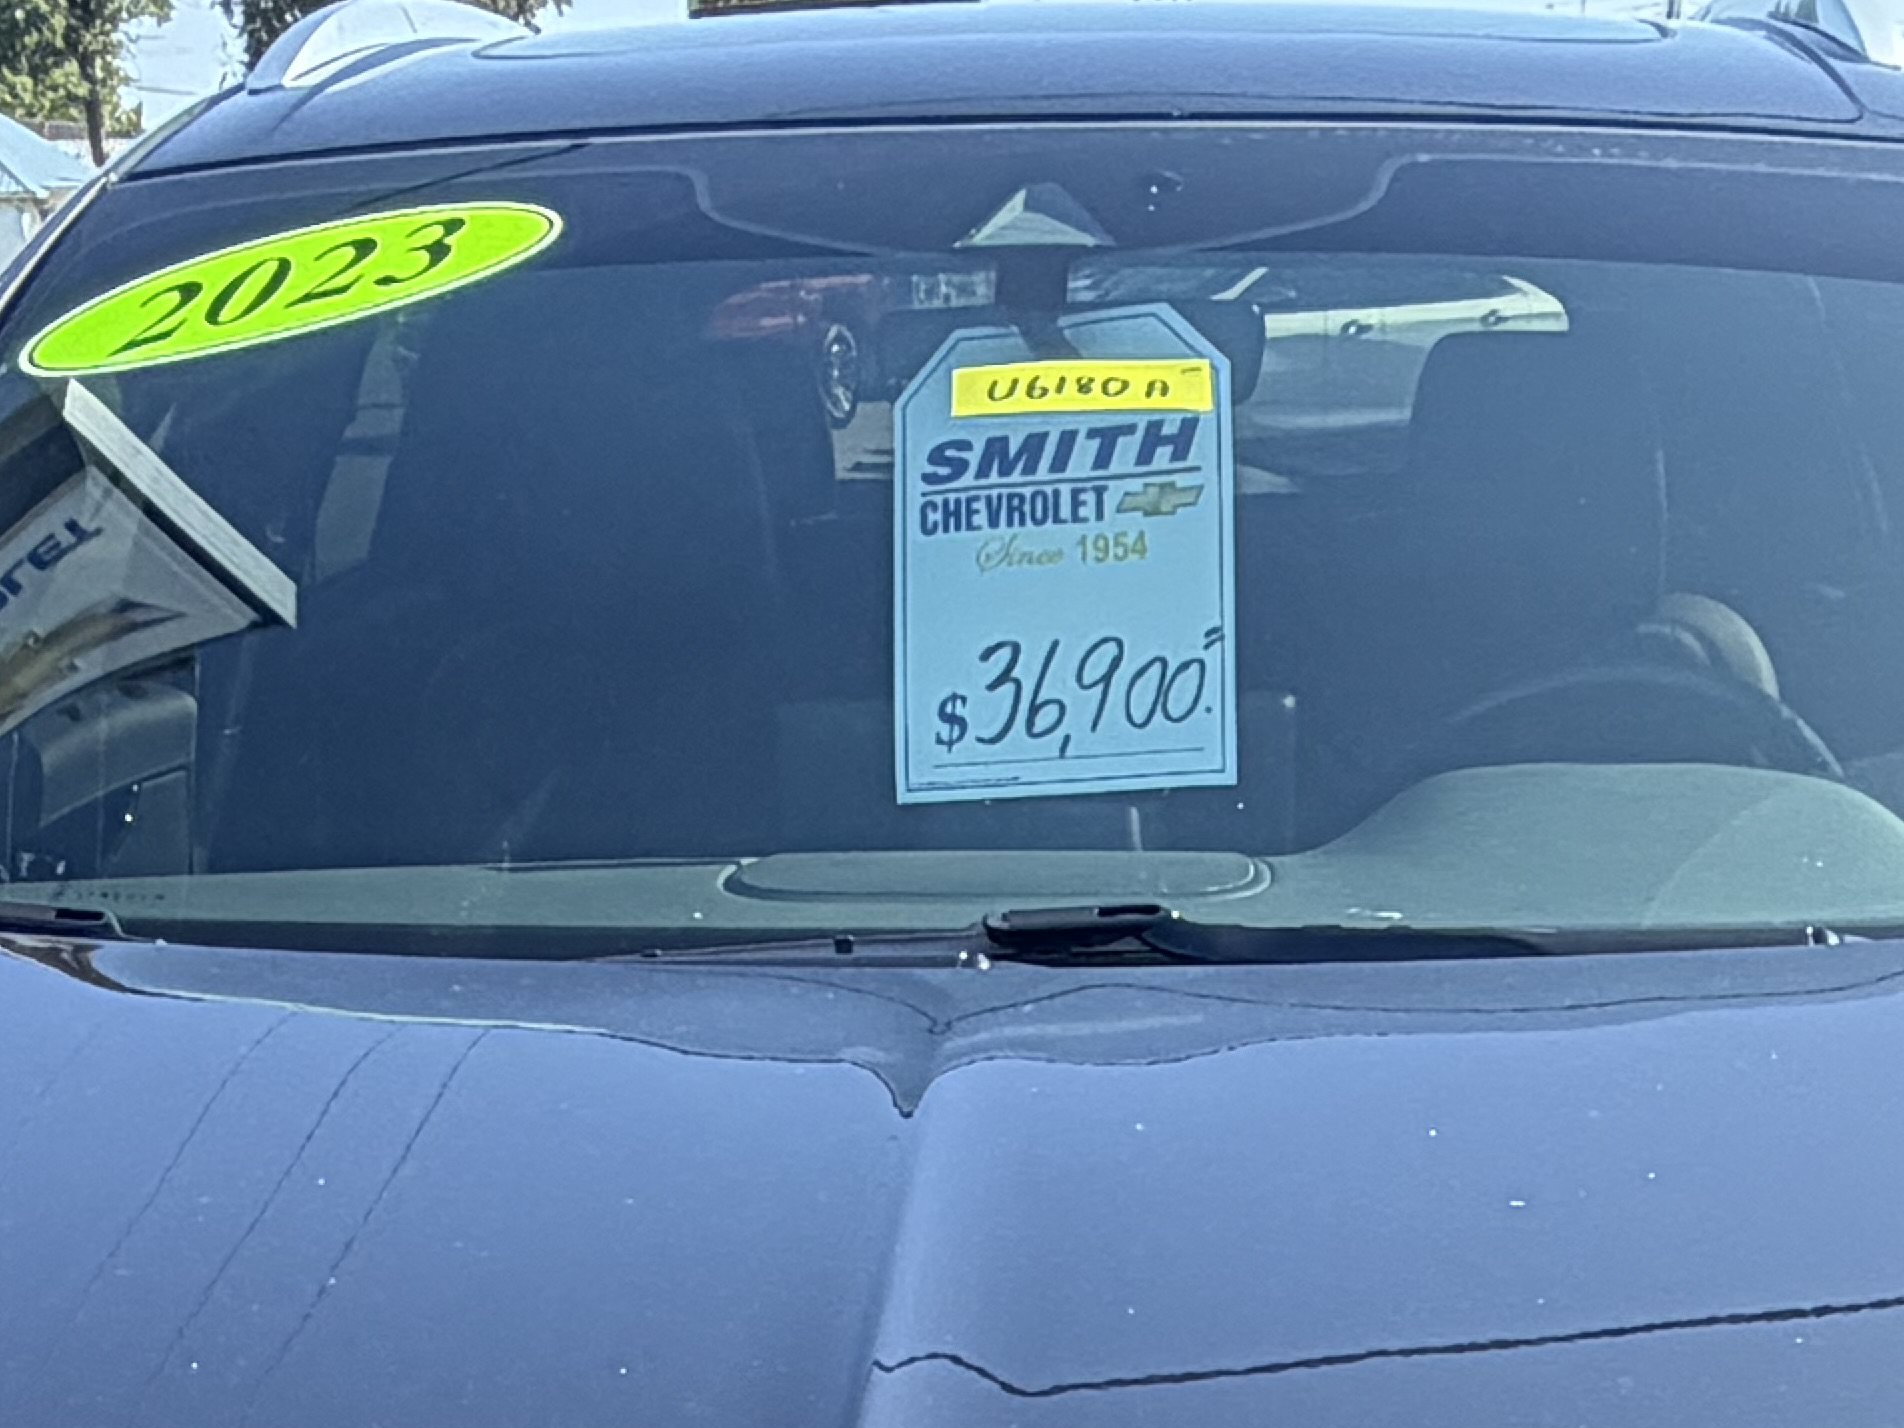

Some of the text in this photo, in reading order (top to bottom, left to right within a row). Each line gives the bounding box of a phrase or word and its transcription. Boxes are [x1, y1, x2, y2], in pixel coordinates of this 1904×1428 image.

[105, 216, 466, 357] 2023
[921, 416, 1200, 486] SMITH
[919, 484, 1108, 538] CHEVROLET
[974, 529, 1148, 572] Since 1954
